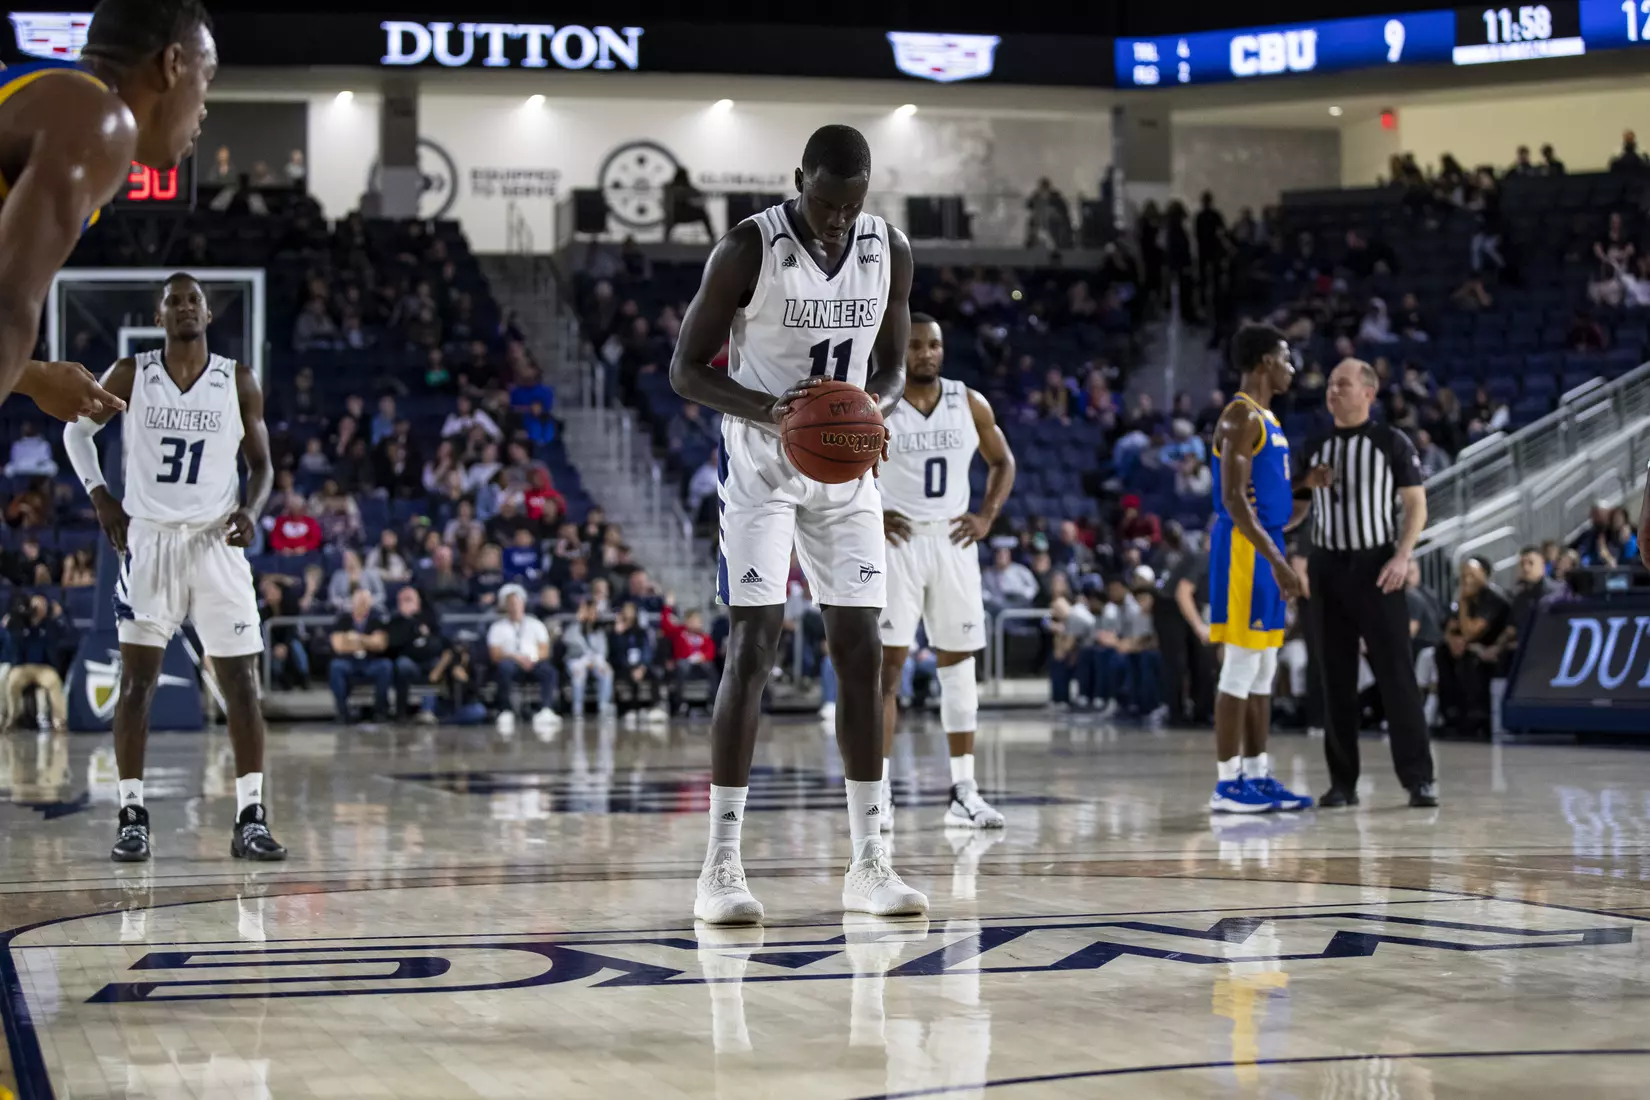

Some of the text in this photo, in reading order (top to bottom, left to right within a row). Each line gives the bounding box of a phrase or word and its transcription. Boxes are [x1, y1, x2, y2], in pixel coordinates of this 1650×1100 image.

[1384, 19, 1406, 63] 9
[1483, 5, 1552, 43] 11:58
[380, 21, 644, 70] DUTTON
[1230, 29, 1318, 77] CBU
[127, 160, 178, 201] 30
[859, 254, 879, 264] WAC
[783, 298, 878, 328] LANCERS
[808, 338, 853, 382] 11
[145, 406, 222, 432] LANCERS
[156, 437, 206, 485] 31
[821, 430, 881, 454] Wilson
[898, 429, 963, 453] LANCERS
[924, 456, 948, 498] 0
[1549, 615, 1650, 690] DU
